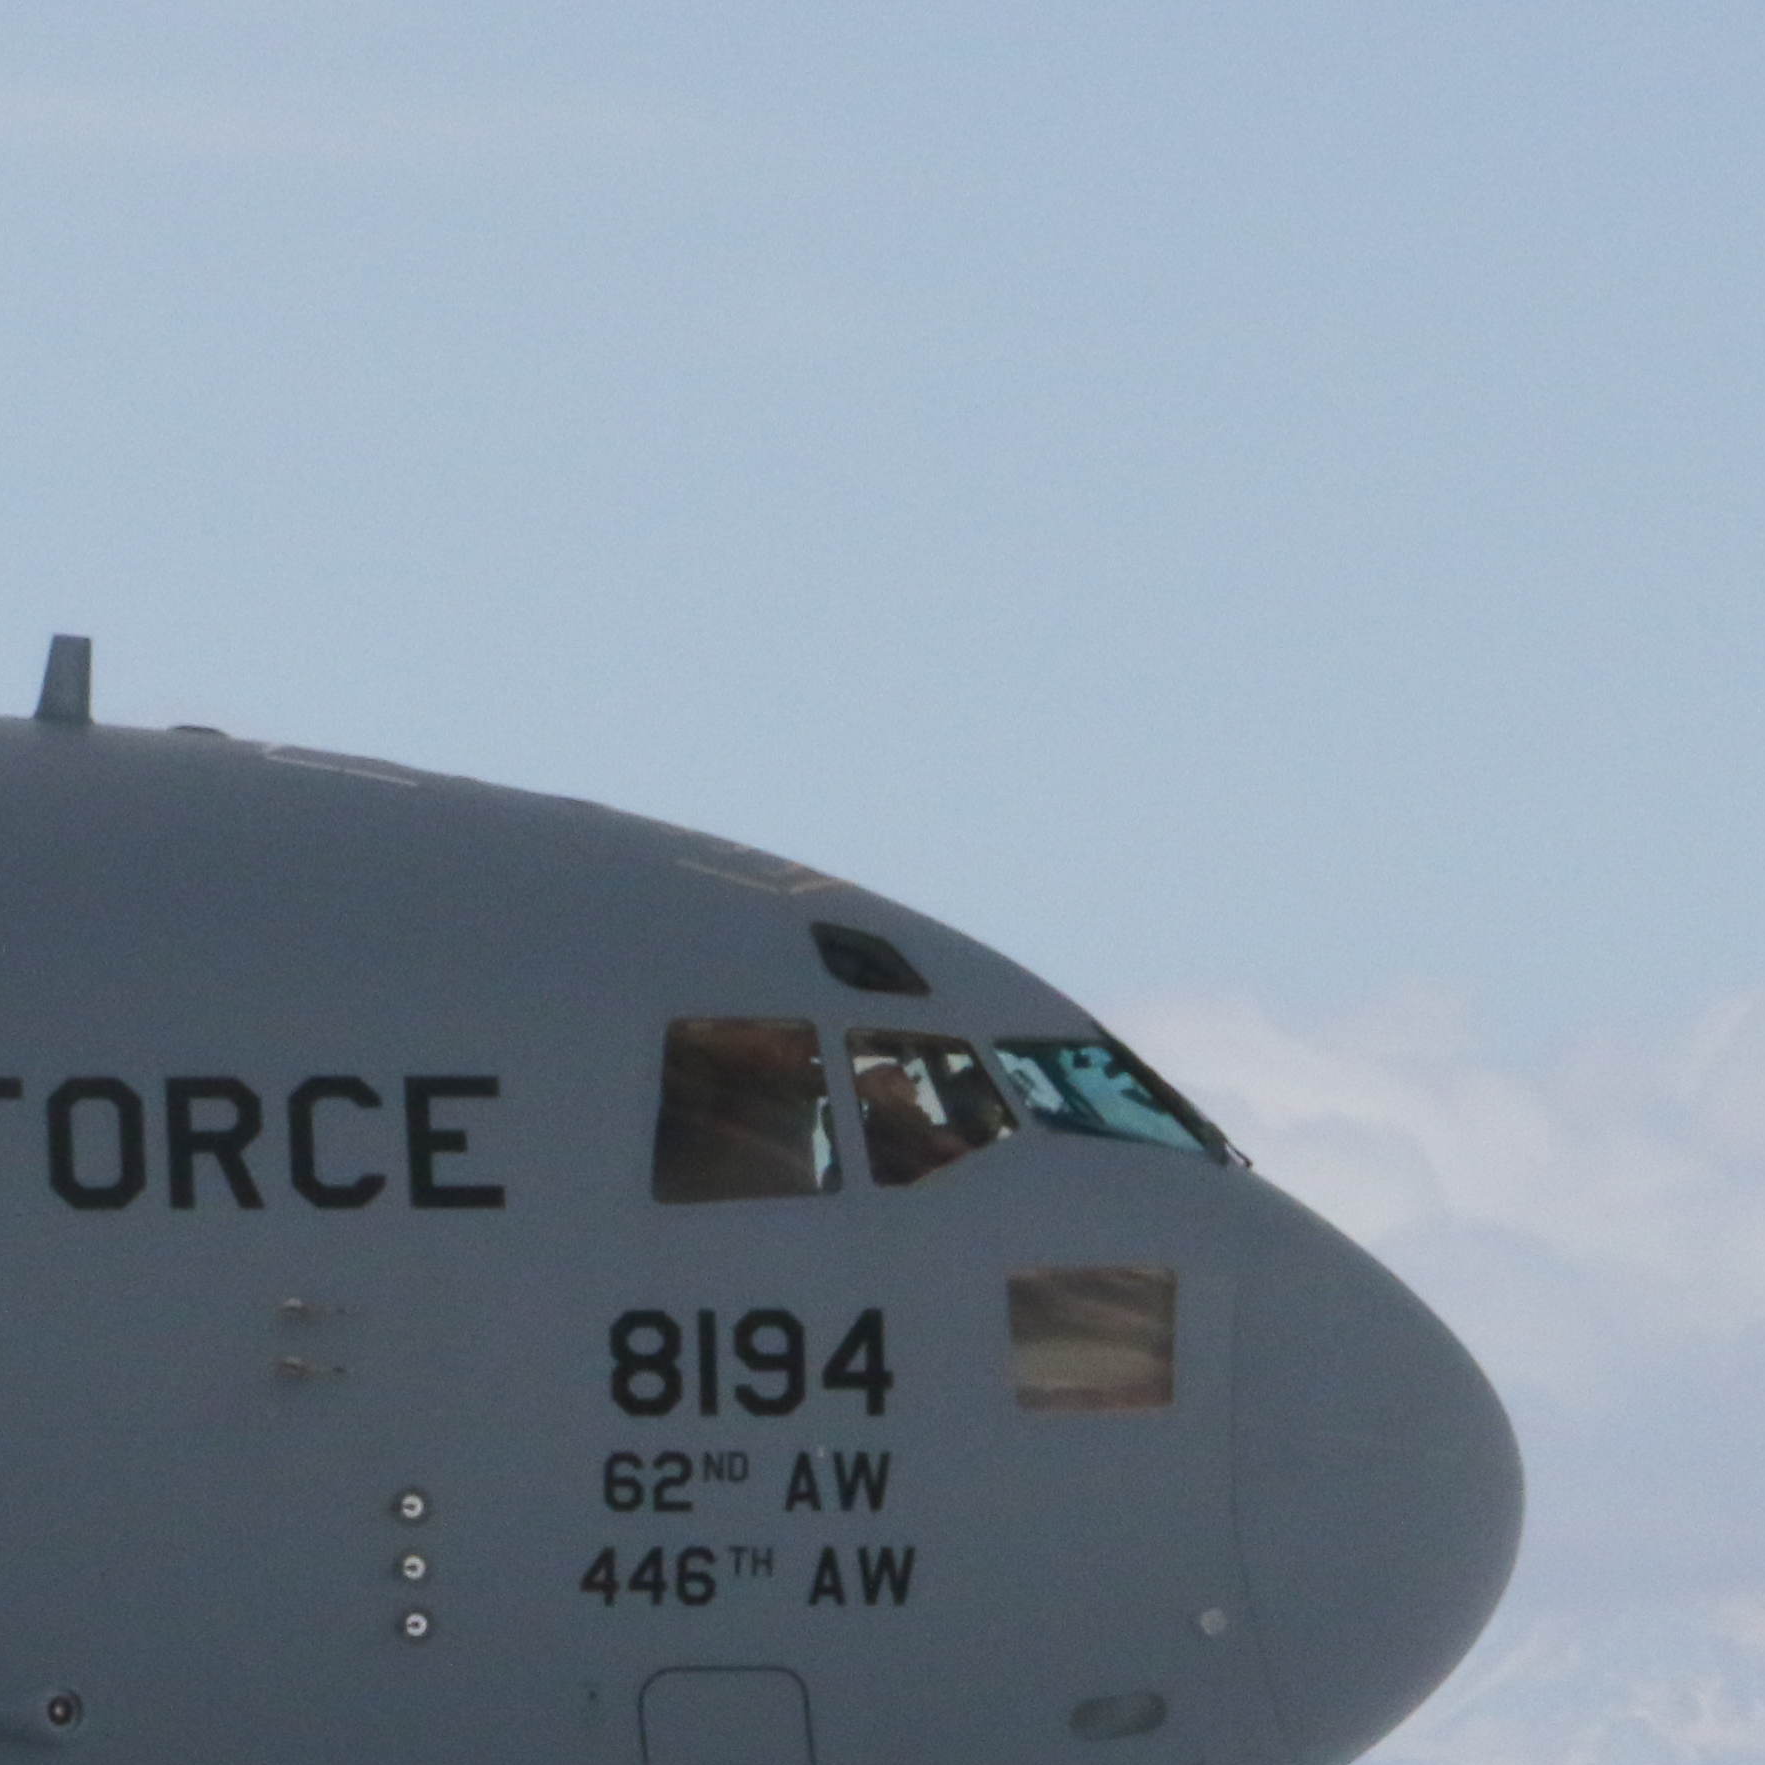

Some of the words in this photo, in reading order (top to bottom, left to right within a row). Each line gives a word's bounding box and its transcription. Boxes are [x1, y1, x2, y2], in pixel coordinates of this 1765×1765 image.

[608, 1307, 895, 1417] 8194
[602, 1449, 749, 1514] 62ND
[784, 1450, 892, 1513] AW
[579, 1544, 774, 1608] 446TH
[806, 1544, 916, 1607] AW
